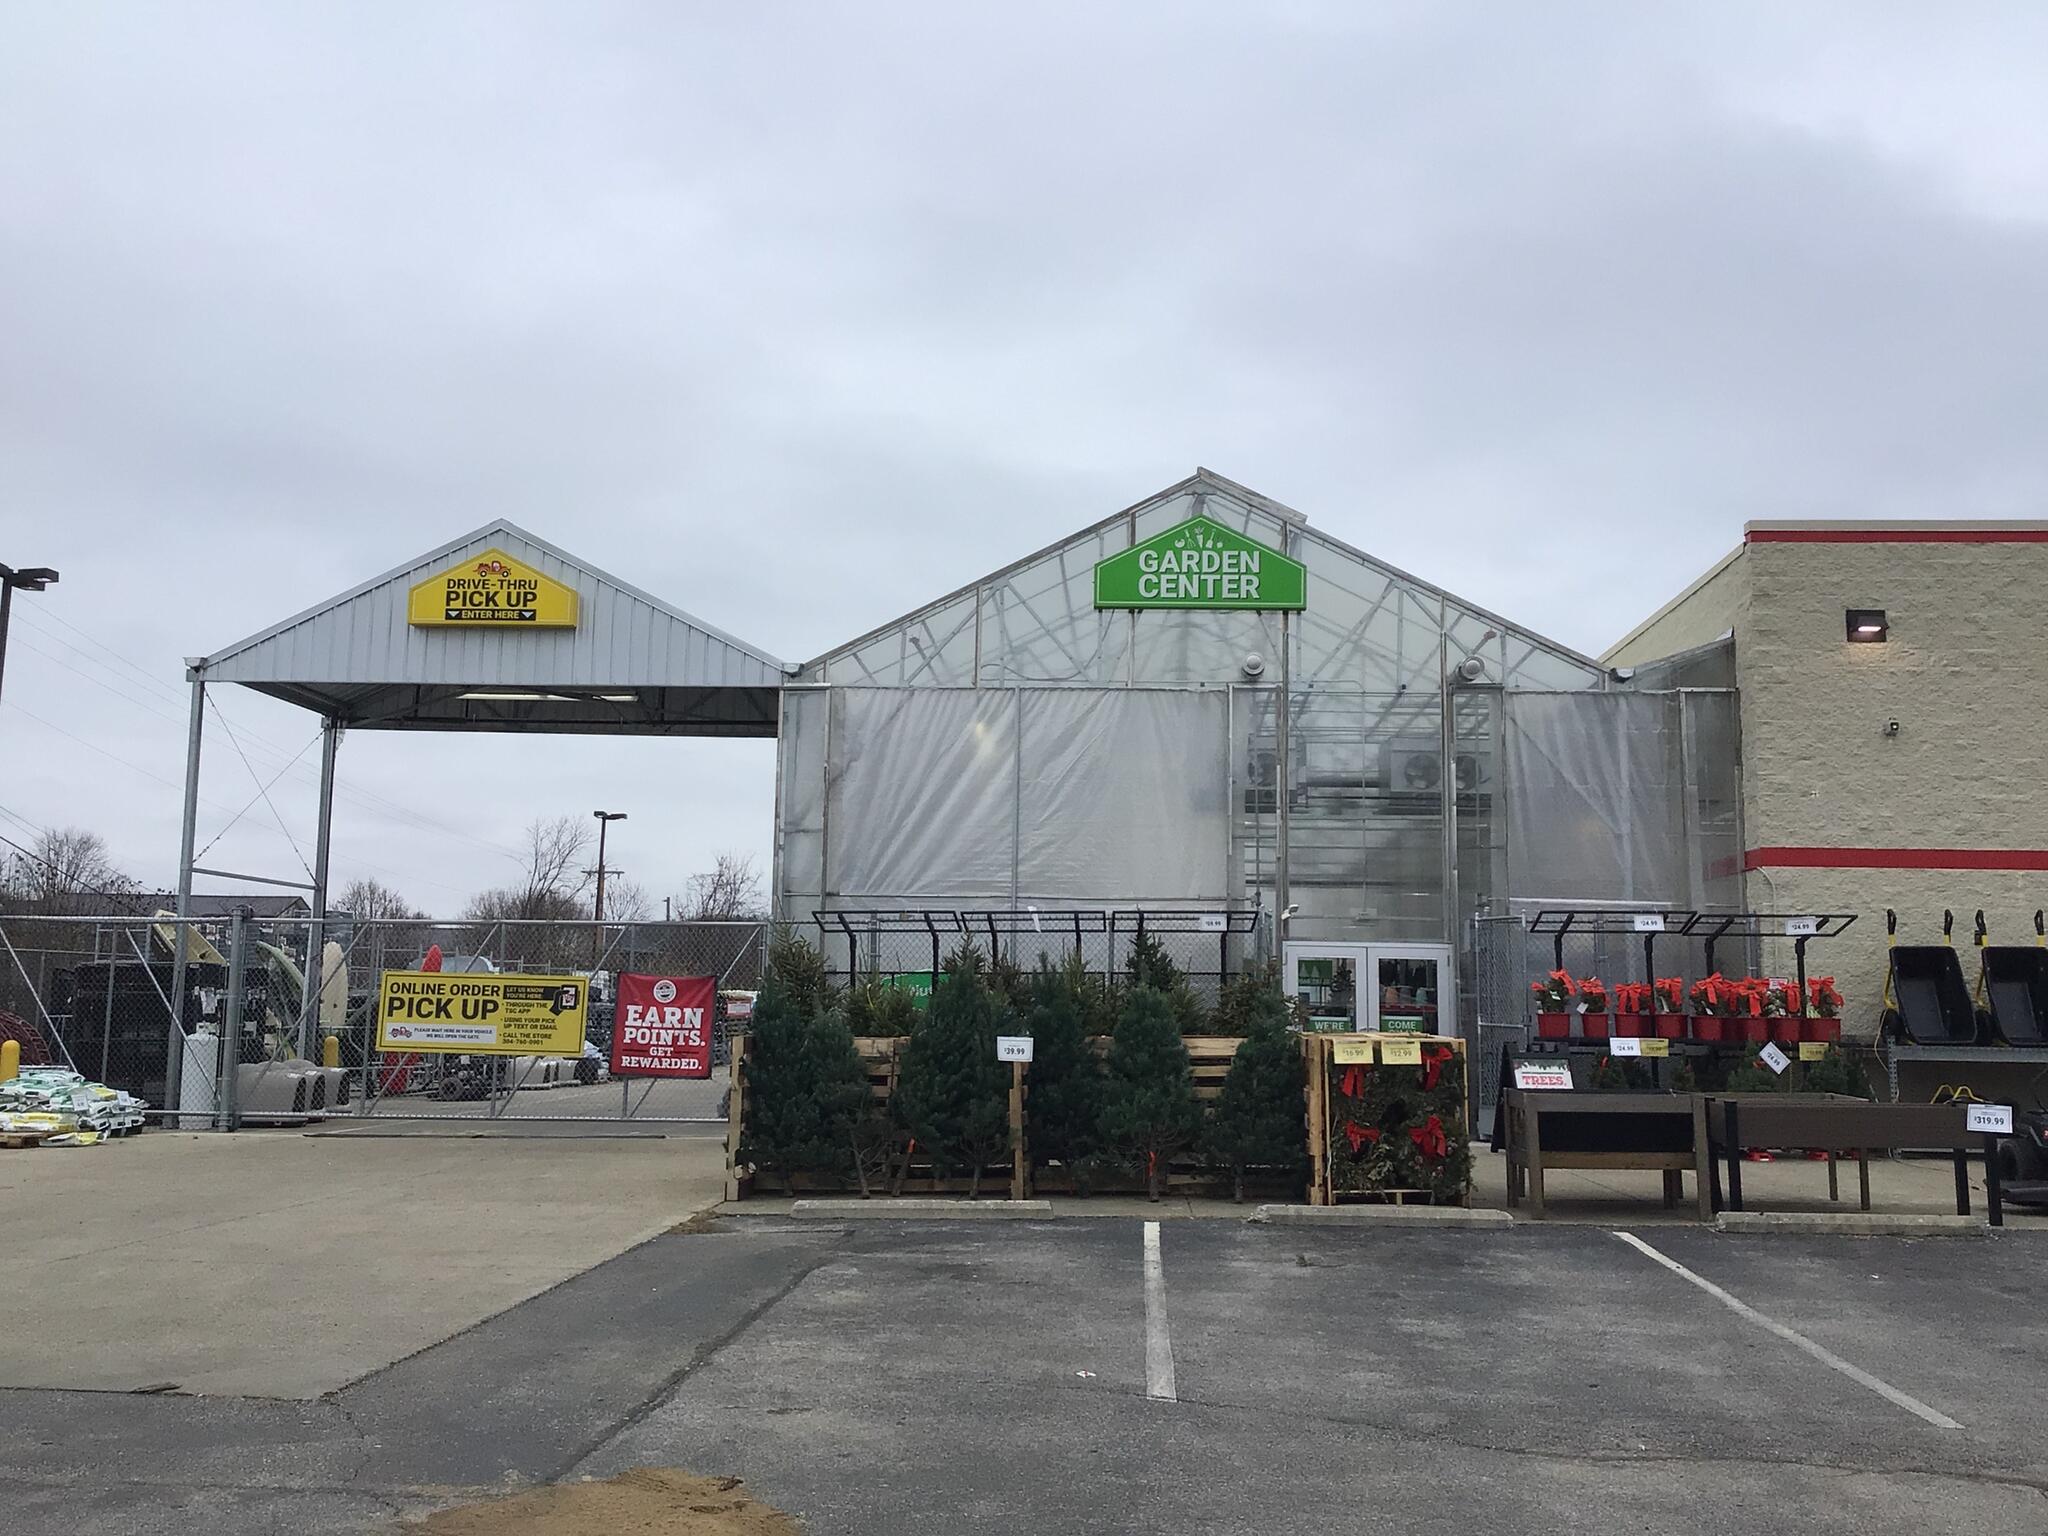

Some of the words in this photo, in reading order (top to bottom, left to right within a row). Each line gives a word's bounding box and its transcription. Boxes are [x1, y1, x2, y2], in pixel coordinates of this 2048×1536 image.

[1138, 549, 1260, 573] GARDEN
[447, 578, 538, 590] DRIVE-THRU
[1138, 573, 1260, 599] CENTER
[446, 590, 500, 607] PICK
[506, 591, 538, 607] UP
[461, 610, 493, 619] ENTER
[494, 610, 520, 619] HERE
[390, 982, 446, 995] ONLINE
[450, 984, 501, 997] ORDER
[387, 996, 454, 1019] PICK
[461, 998, 500, 1020] UP
[624, 1005, 704, 1029] EARN
[1314, 1021, 1345, 1030] WE'RE
[1387, 1020, 1416, 1030] COME
[623, 1027, 706, 1047] POINTS.
[649, 1047, 674, 1056] GET
[1003, 1047, 1026, 1055] $39.99
[621, 1056, 703, 1070] REWARDED.
[1974, 1115, 2005, 1126] $319.99
